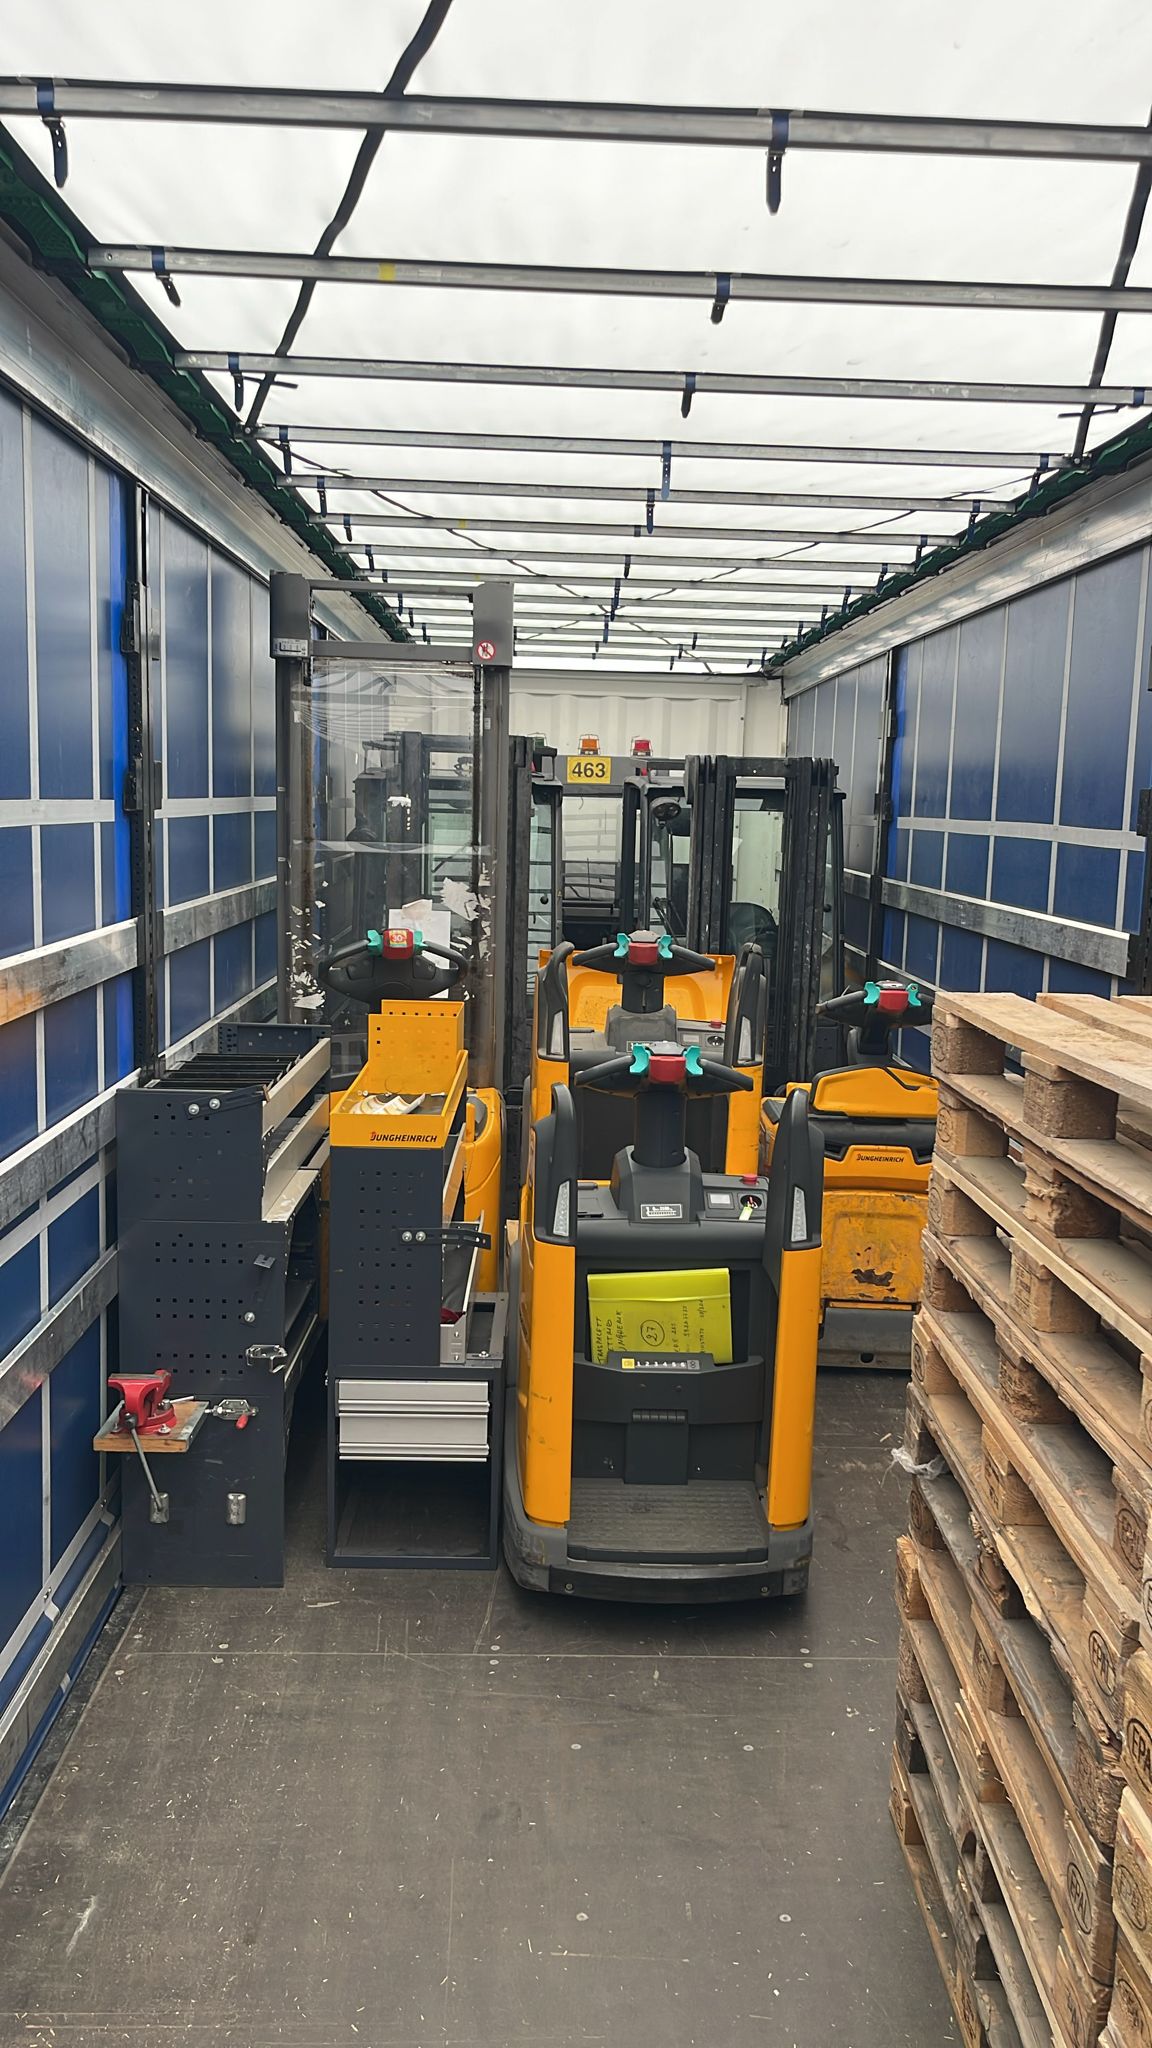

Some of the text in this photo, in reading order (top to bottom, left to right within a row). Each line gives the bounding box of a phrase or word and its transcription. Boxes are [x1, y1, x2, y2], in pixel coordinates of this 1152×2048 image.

[572, 762, 606, 778] 463
[370, 1131, 438, 1143] JUNGHEINRICH
[856, 1153, 904, 1163] JUNGHEINRICH
[1131, 1724, 1152, 1784] EPA
[1069, 1867, 1089, 1930] EPAL
